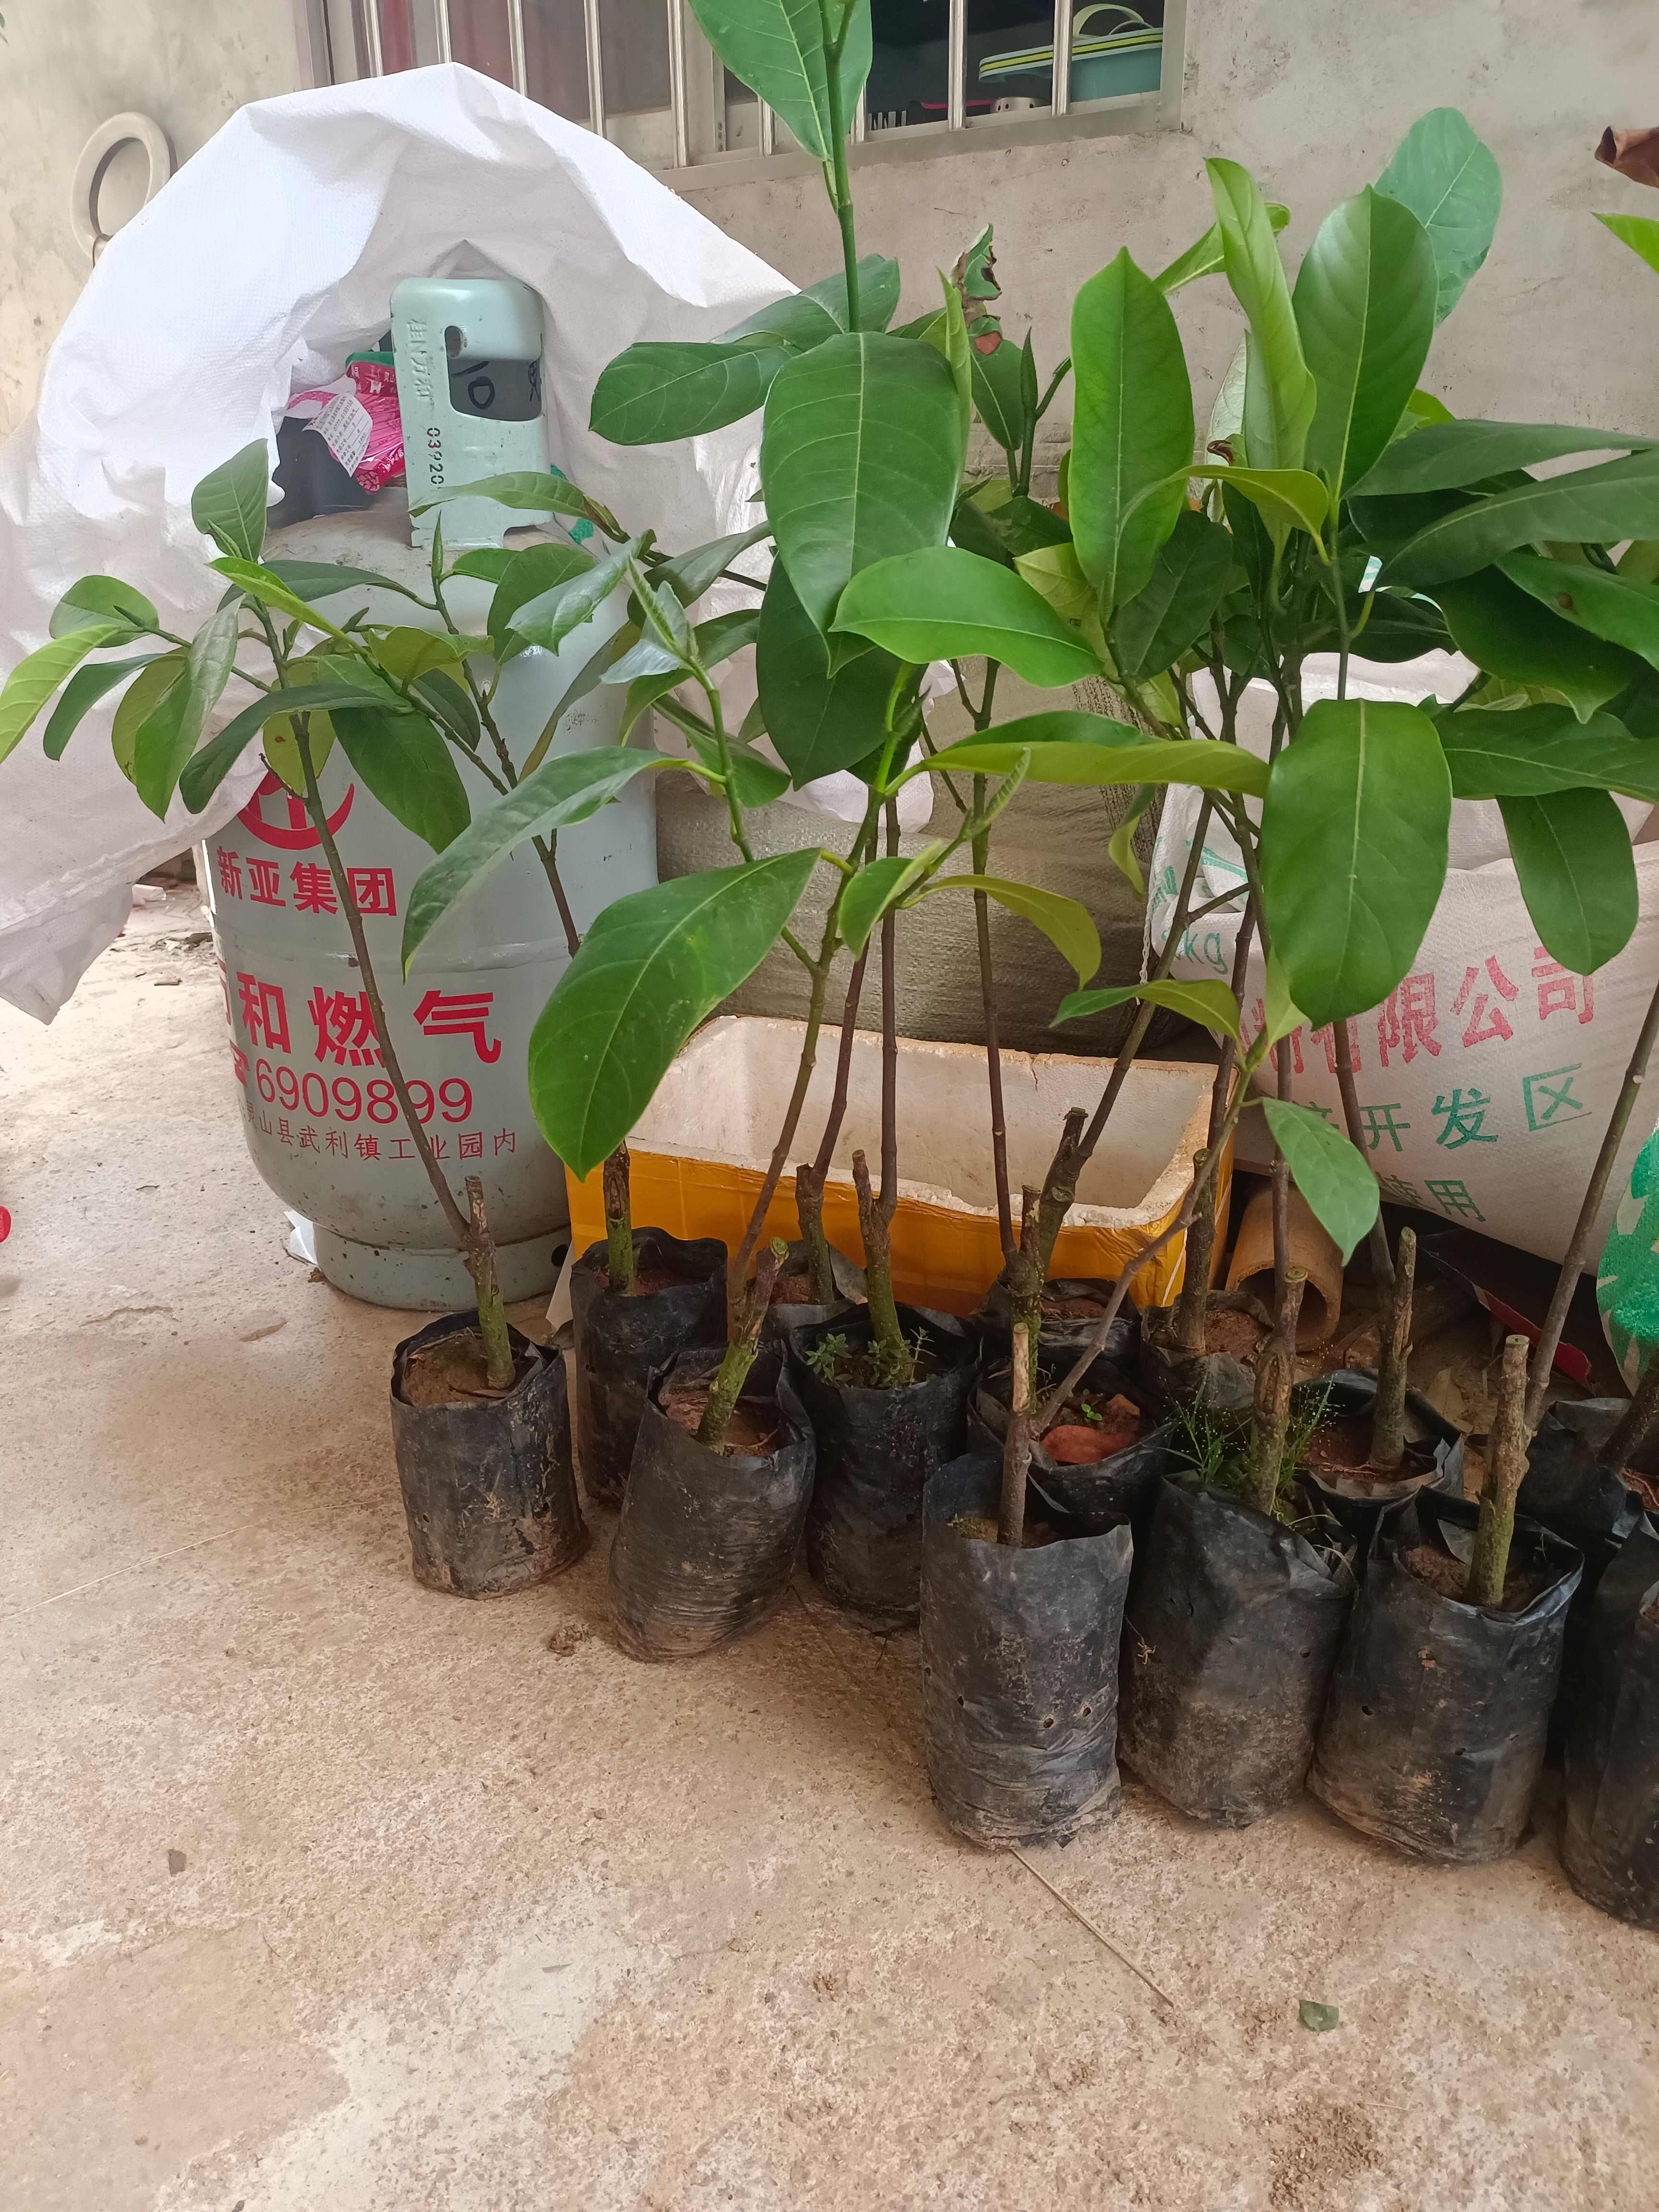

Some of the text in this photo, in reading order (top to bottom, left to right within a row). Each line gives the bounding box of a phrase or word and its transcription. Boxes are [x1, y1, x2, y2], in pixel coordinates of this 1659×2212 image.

[217, 845, 397, 916] 新亚集团
[256, 1058, 473, 1124] 6909899
